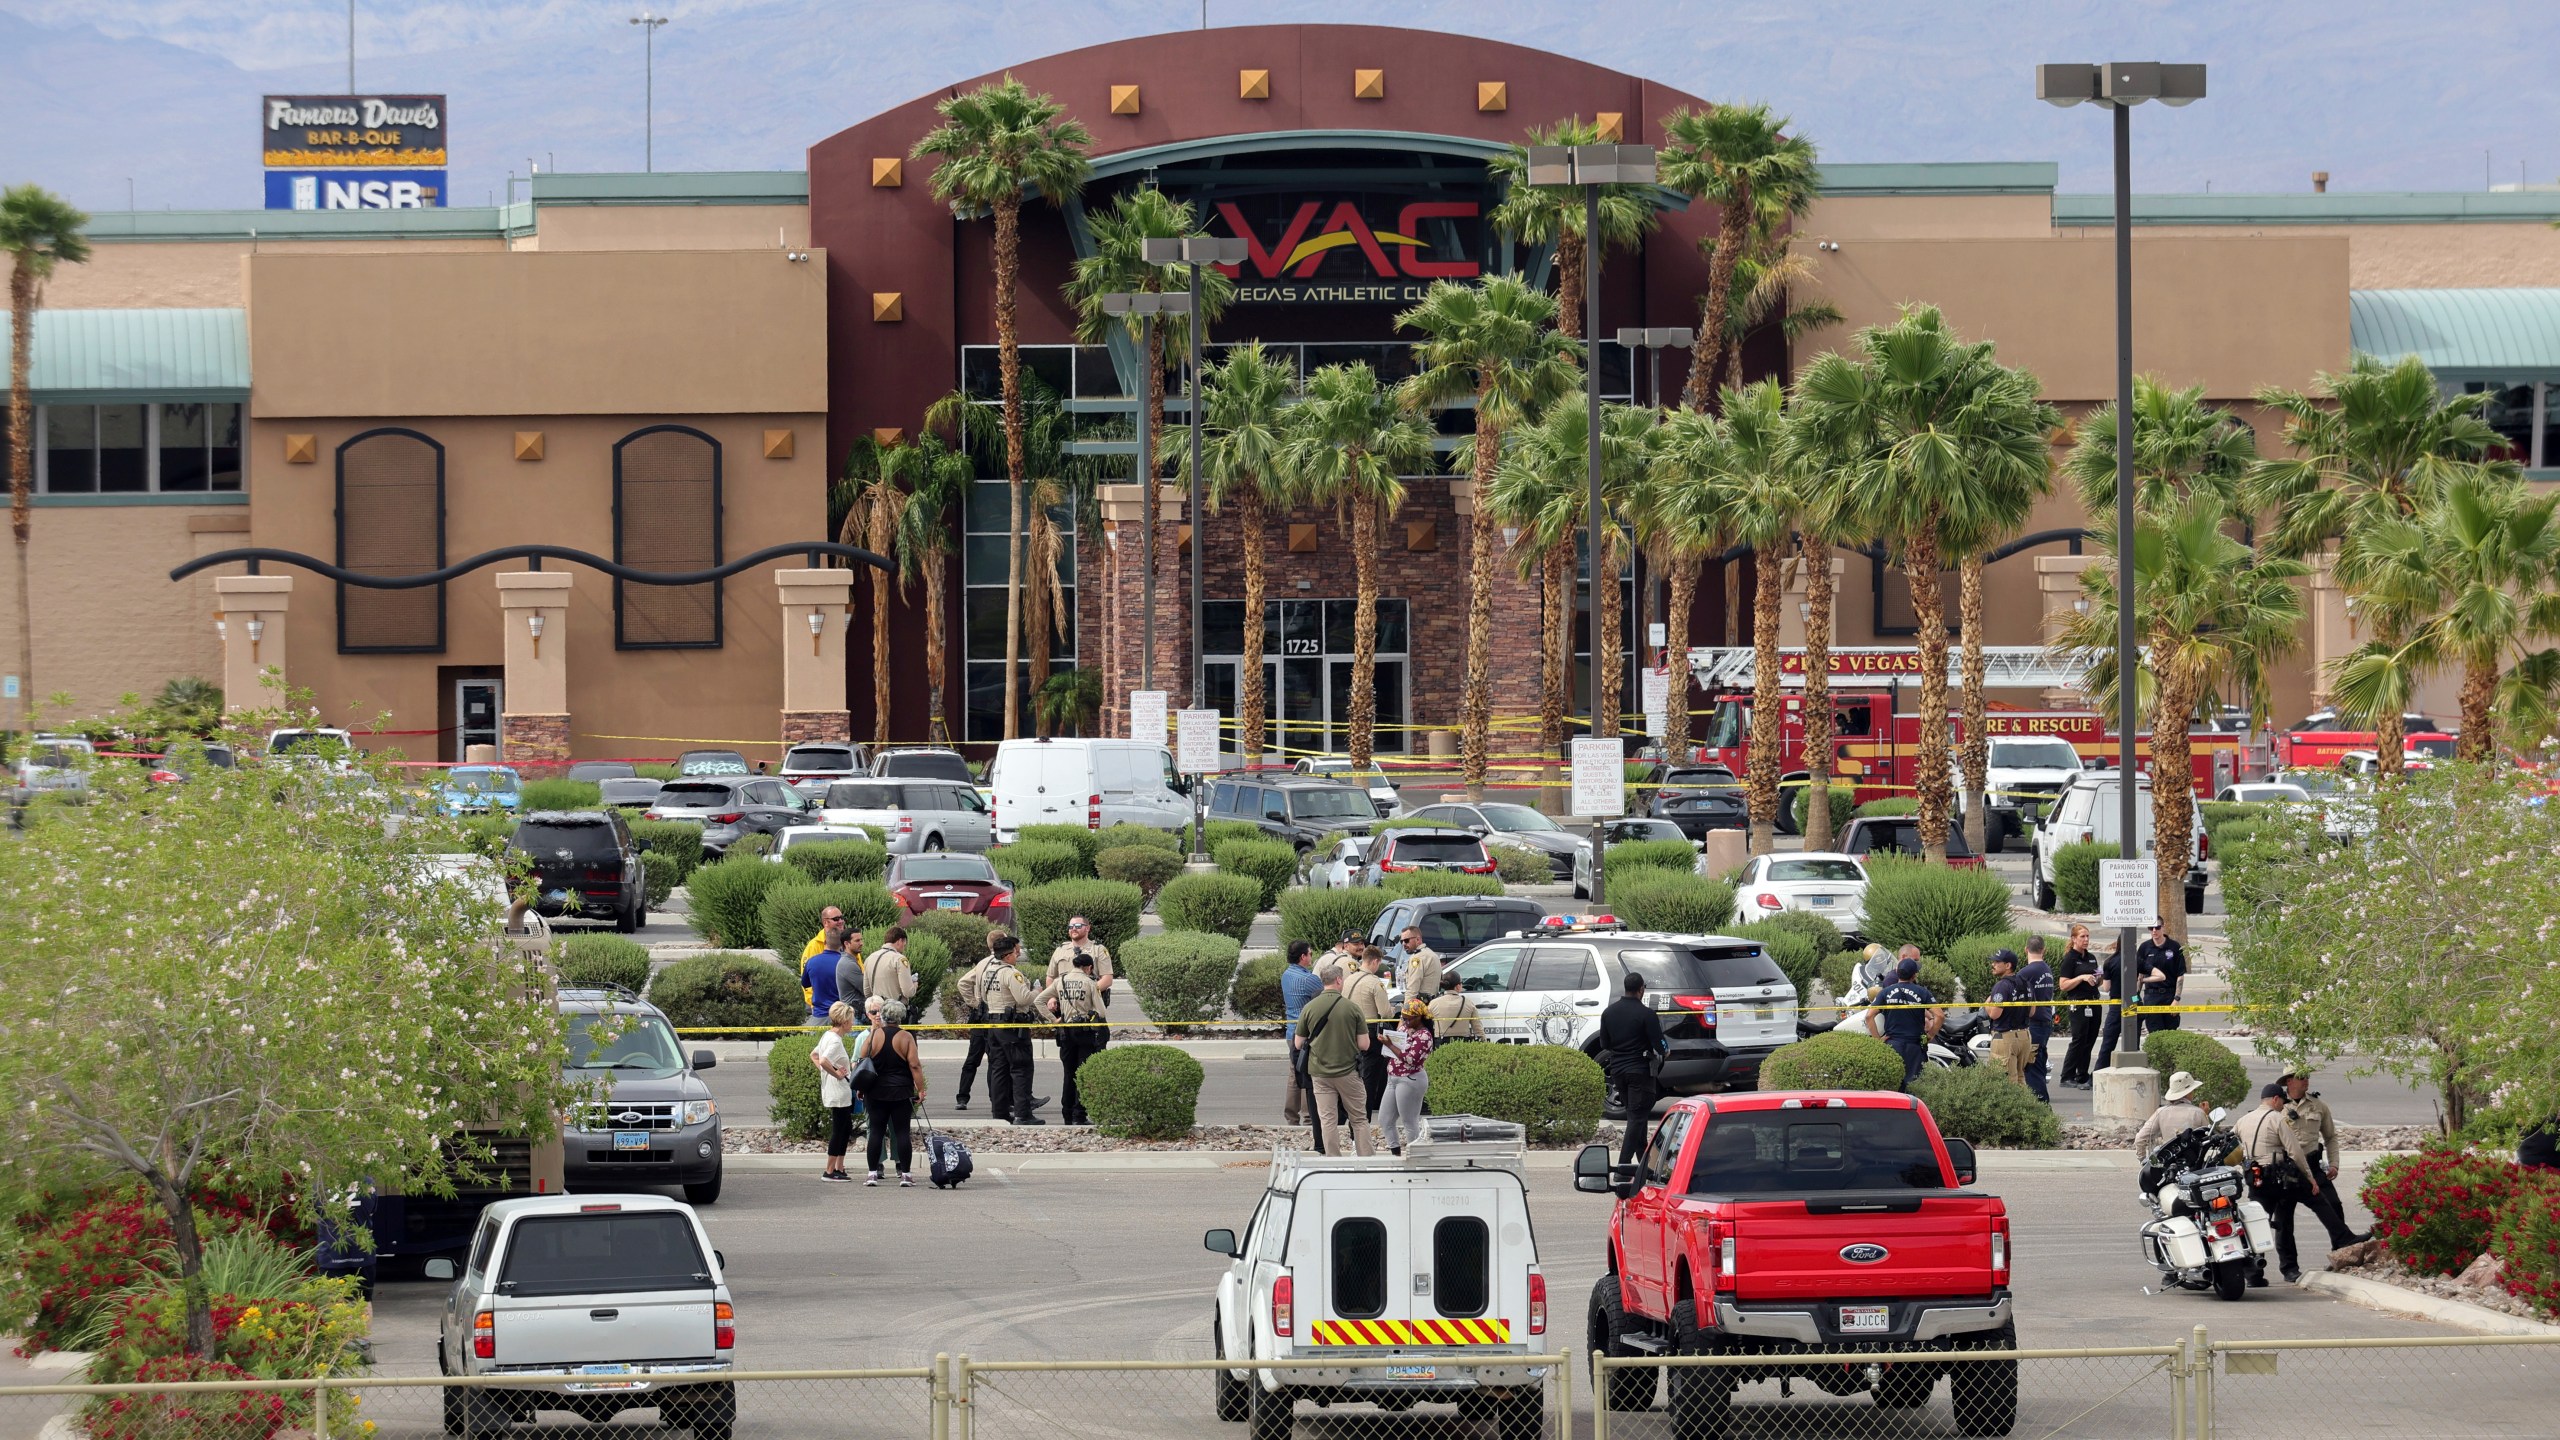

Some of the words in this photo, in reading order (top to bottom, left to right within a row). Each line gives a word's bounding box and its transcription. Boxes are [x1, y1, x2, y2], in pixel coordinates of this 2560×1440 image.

[269, 100, 359, 130] Famous
[362, 99, 438, 129] Dave's
[307, 130, 402, 145] BAR-B-QUE
[1212, 202, 1479, 278] VAC
[1232, 287, 1297, 301] VEGAS
[1303, 286, 1396, 301] ATHLETIC
[1286, 639, 1319, 654] 1725
[1801, 656, 1840, 671] LS
[1849, 656, 1919, 671] VEGAS
[1986, 719, 2007, 732] RE
[2012, 719, 2022, 732] &
[2028, 718, 2092, 732] RESCUE
[1853, 980, 1864, 994] POL
[1059, 990, 1086, 1001] POLICE
[1886, 987, 1899, 999] LAS
[1901, 987, 1922, 1003] VEGAS
[1484, 1027, 1523, 1035] OPOLITAN
[2200, 1172, 2232, 1183] POLICE
[1851, 1248, 1877, 1259] Ford
[1775, 1278, 1873, 1287] SUPER
[1880, 1276, 1954, 1286] DUTY
[502, 1312, 545, 1321] TOYOTA
[1856, 1314, 1886, 1326] JJCCR
